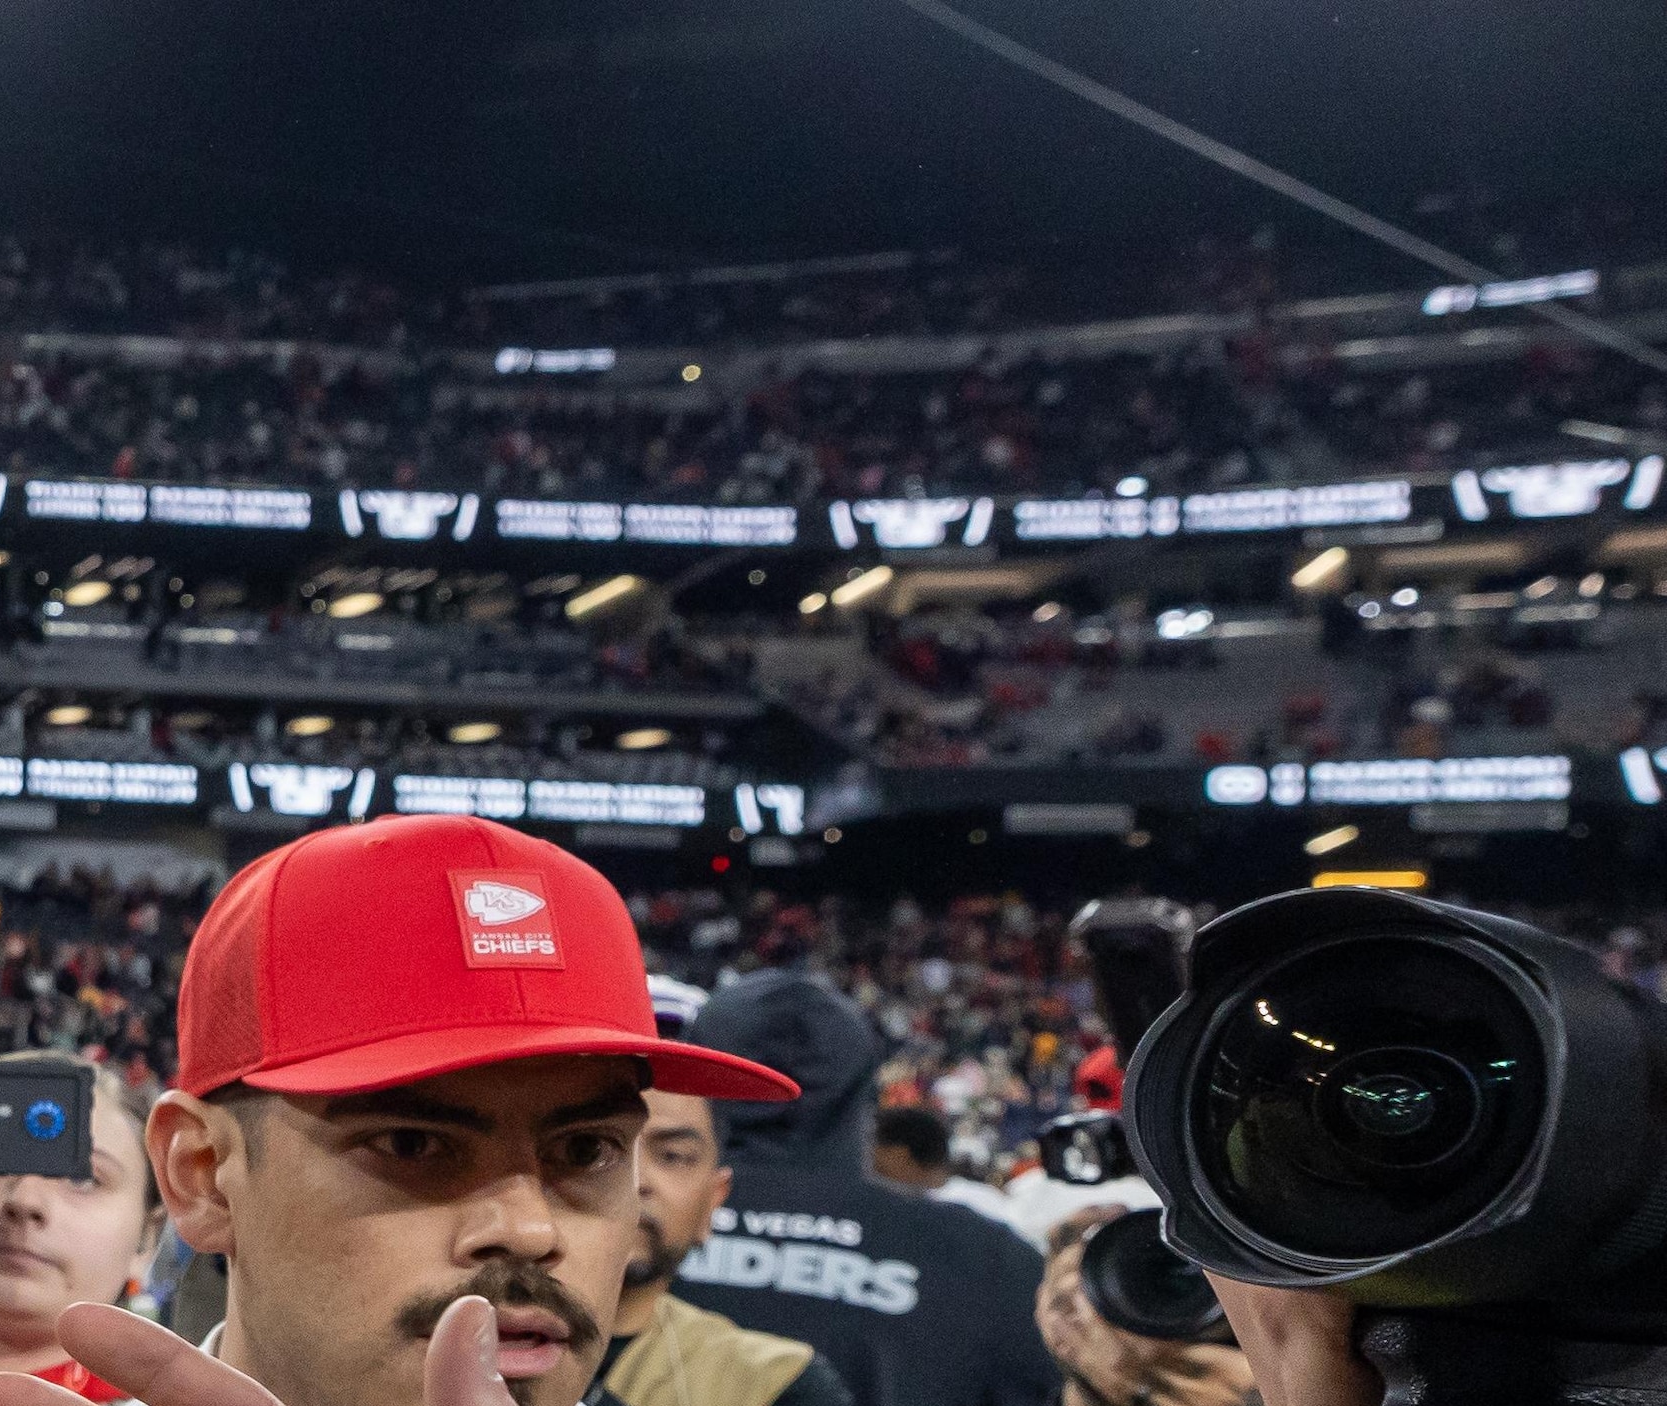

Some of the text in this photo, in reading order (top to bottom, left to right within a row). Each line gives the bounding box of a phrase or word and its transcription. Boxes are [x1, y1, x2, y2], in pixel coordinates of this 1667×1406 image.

[473, 939, 556, 955] CHIEFS
[743, 1211, 862, 1246] VEGAS
[675, 1234, 919, 1315] IDERS
